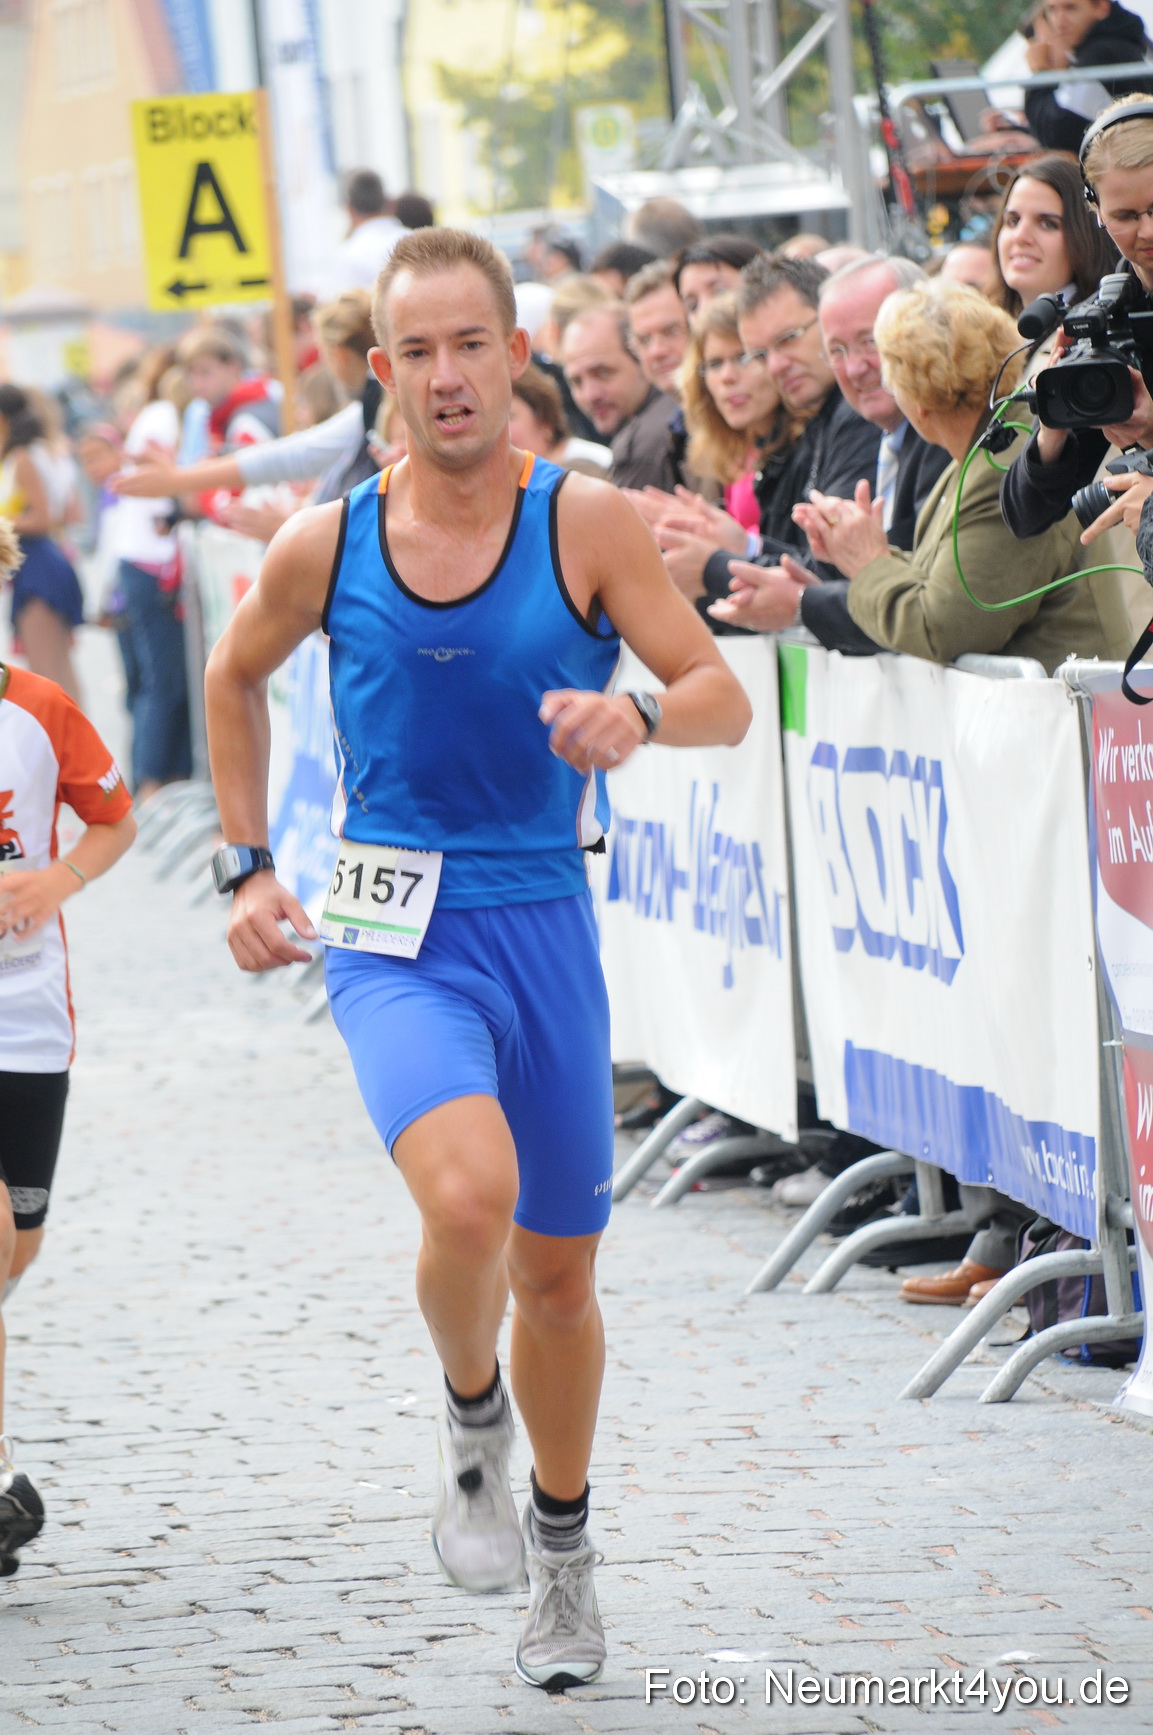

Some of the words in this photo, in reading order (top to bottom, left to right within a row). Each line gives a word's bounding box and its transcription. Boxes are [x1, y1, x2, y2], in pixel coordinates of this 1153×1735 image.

[147, 100, 257, 142] Block
[178, 163, 248, 258] A
[1098, 726, 1118, 783] Wir
[808, 741, 965, 987] BOCK
[1107, 809, 1127, 864] im
[333, 859, 424, 908] 5157
